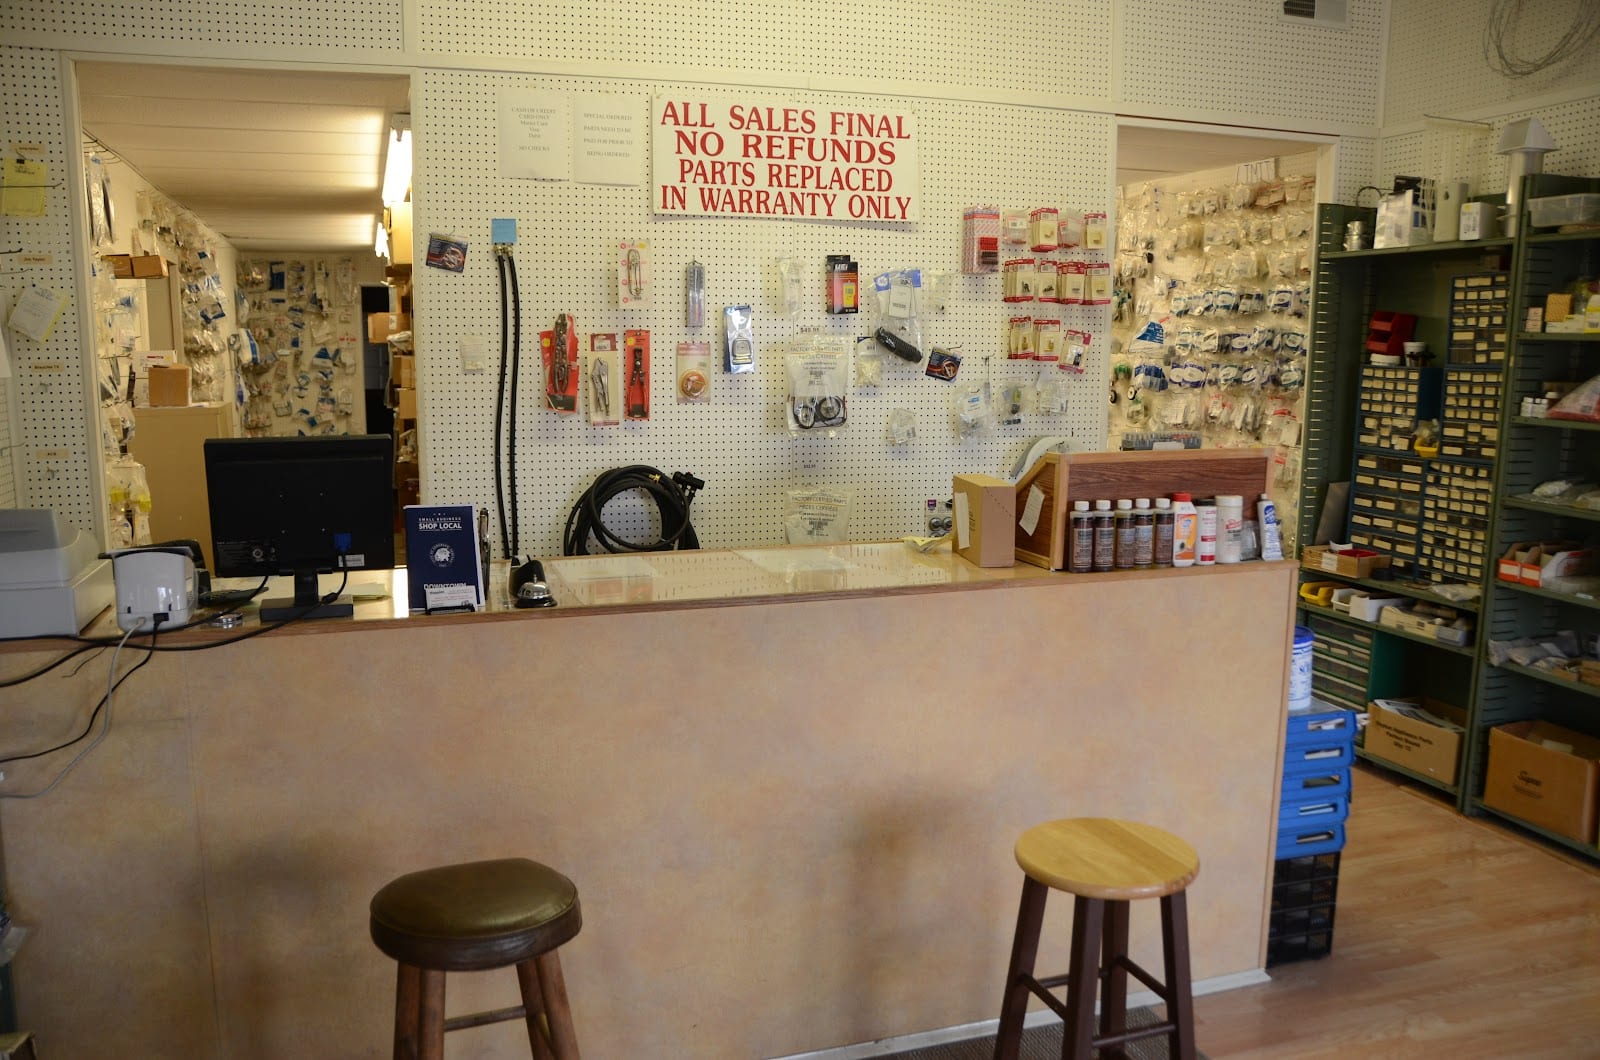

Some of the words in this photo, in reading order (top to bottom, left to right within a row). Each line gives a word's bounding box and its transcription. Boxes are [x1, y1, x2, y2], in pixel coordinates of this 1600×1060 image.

[661, 101, 715, 128] ALL
[729, 105, 816, 134] SALES
[830, 111, 911, 139] FINAL
[675, 130, 724, 157] NO
[741, 134, 896, 165] REFUNDS
[679, 159, 755, 187] PARTS
[767, 163, 893, 192] REPLACED
[661, 185, 687, 210] IN
[699, 187, 838, 216] WARRANTY
[848, 194, 912, 220] ONLY
